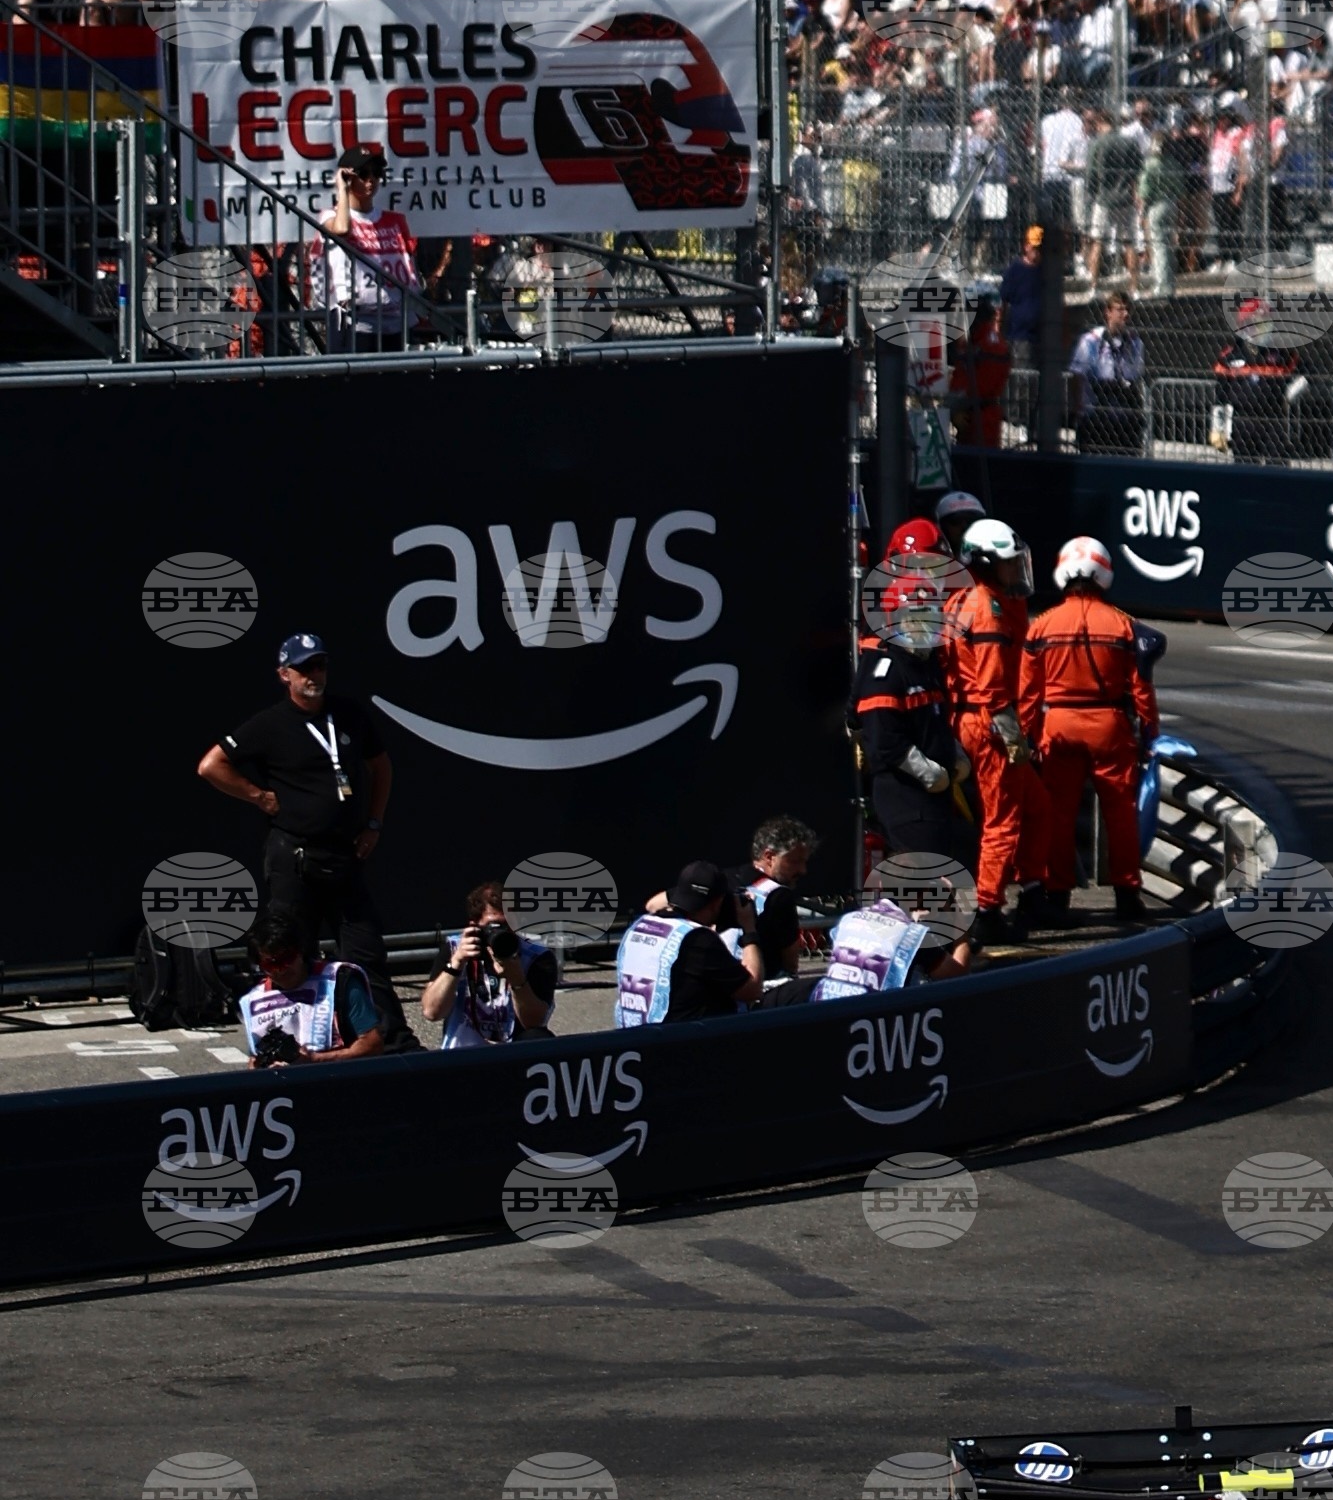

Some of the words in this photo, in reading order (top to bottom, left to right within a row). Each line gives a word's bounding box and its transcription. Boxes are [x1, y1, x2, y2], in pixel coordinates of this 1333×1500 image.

[240, 22, 538, 84] CHARLES
[192, 84, 530, 163] LECLERC
[271, 167, 334, 191] THE
[379, 164, 505, 190] FFICIAL
[389, 190, 447, 211] FAN
[468, 187, 547, 210] CLUB
[1125, 486, 1201, 541] aws
[386, 511, 723, 658] aws
[658, 931, 684, 987] MONACO
[1087, 963, 1150, 1033] aws
[846, 1007, 945, 1079] aws
[522, 1051, 643, 1124] aws
[158, 1097, 296, 1171] aws
[1025, 1444, 1067, 1481] hp
